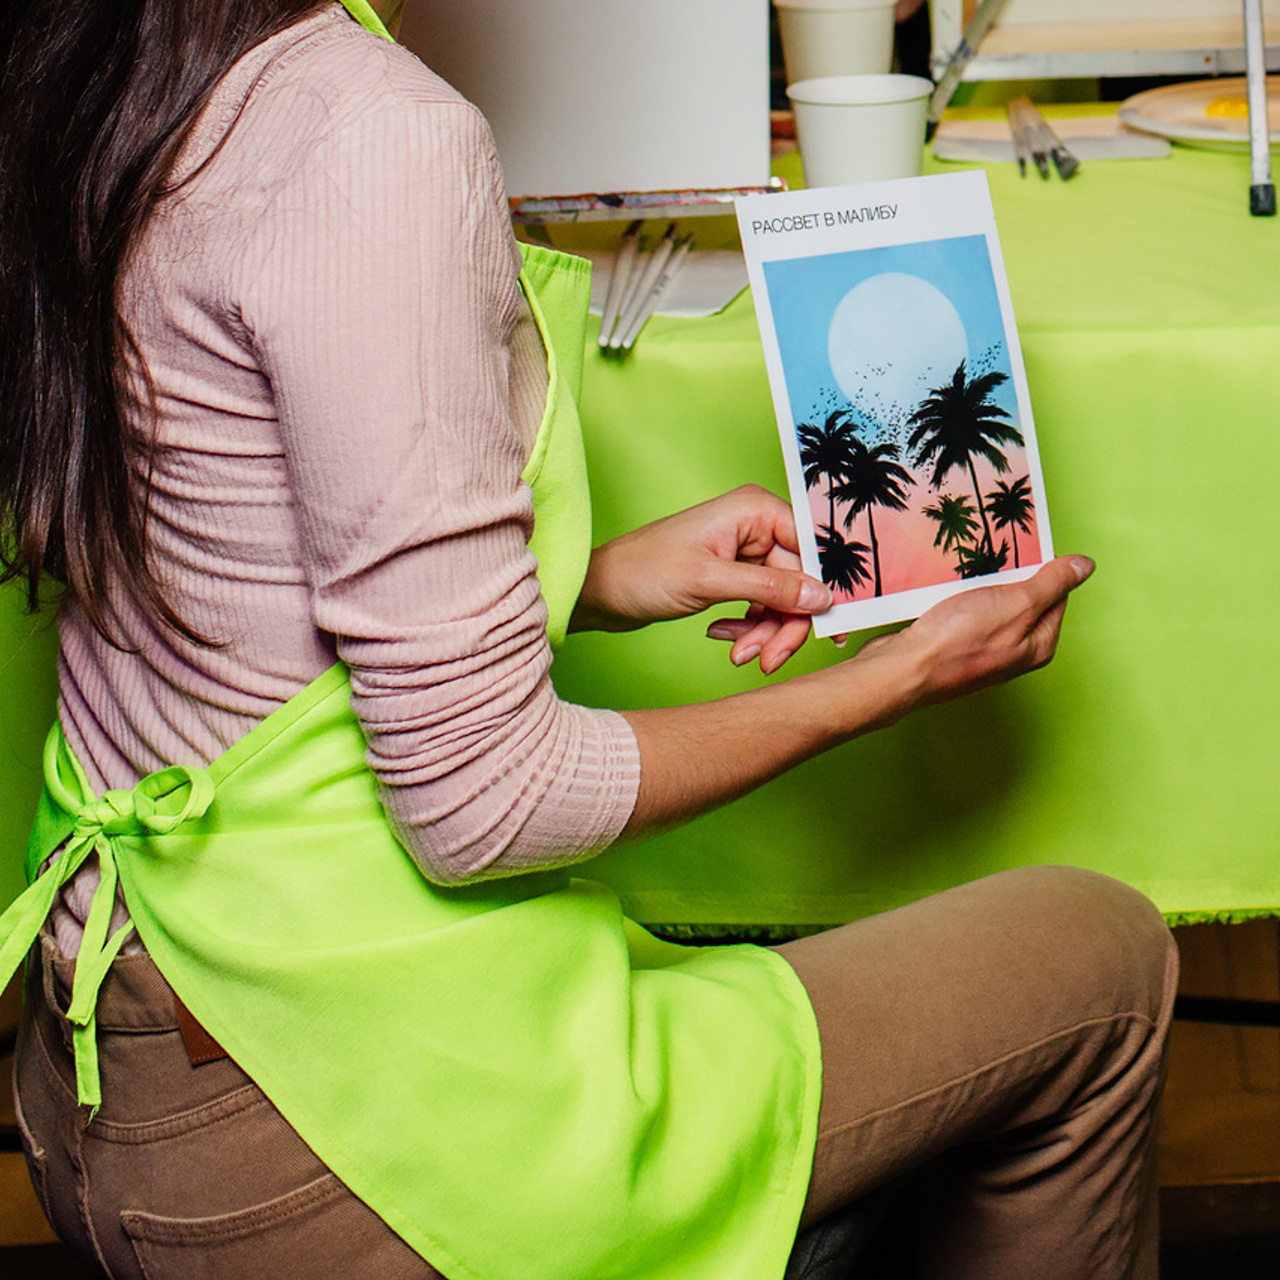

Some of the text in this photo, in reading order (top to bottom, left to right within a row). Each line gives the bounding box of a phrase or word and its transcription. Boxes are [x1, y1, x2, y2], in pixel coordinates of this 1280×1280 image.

[752, 204, 898, 235] РАССВЕТ В МАЛИБУ
